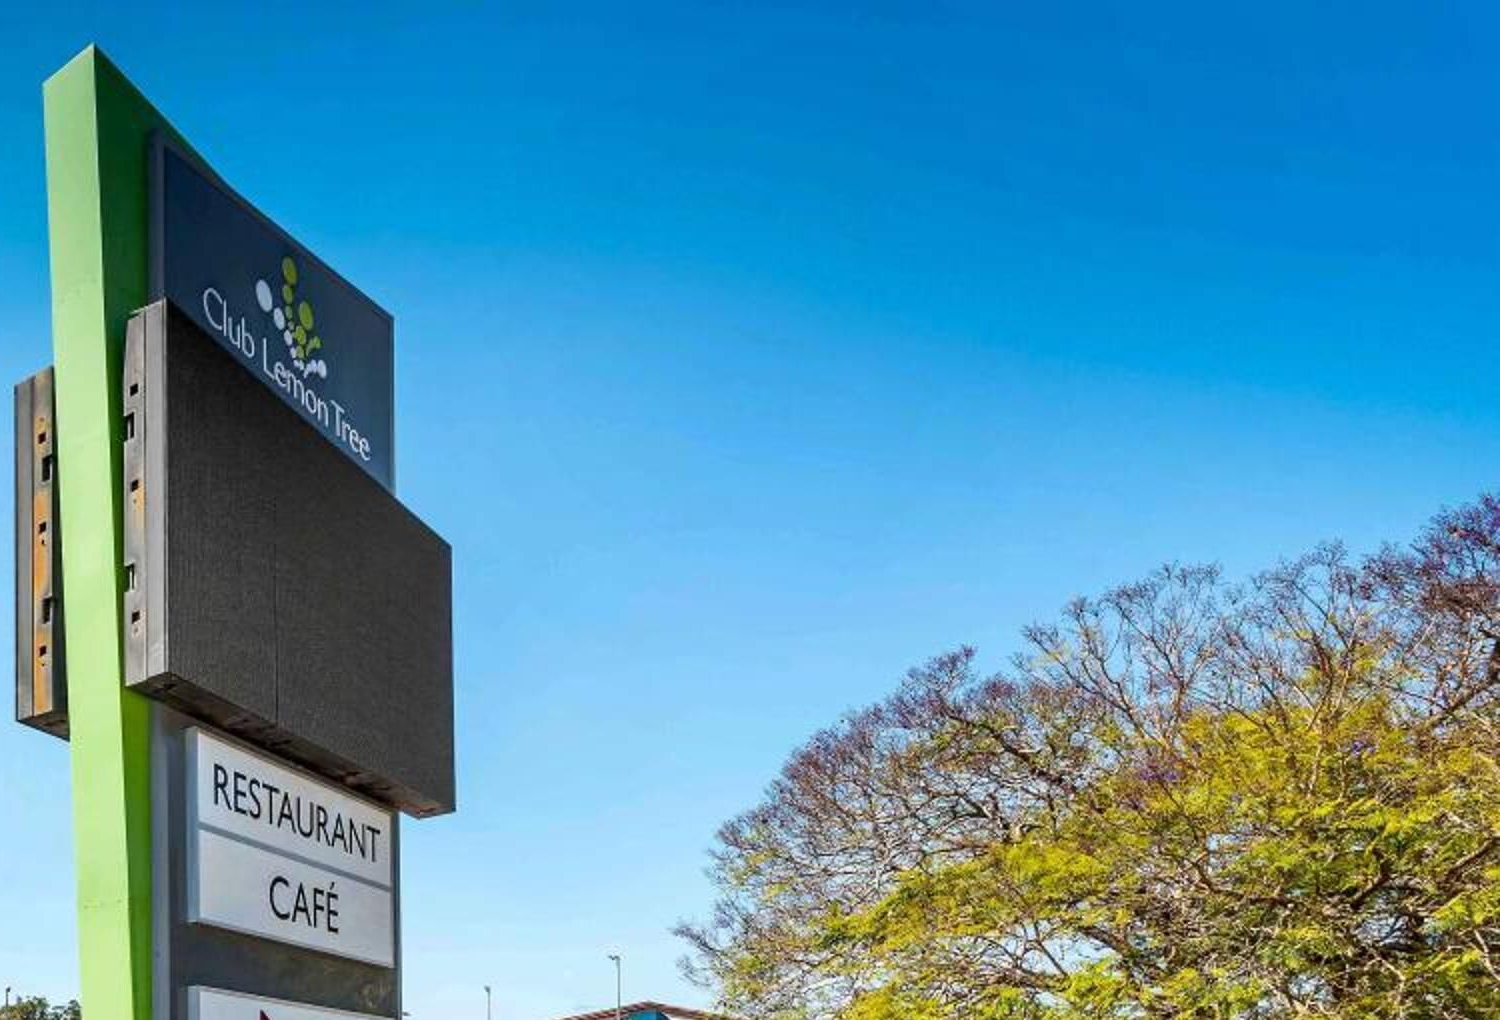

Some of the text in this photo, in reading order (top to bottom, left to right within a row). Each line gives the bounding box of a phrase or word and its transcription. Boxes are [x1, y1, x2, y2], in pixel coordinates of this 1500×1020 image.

[203, 288, 370, 461] Club Lemon Tree
[213, 763, 381, 862] RESTAURANT
[269, 876, 339, 933] CAFÉ
